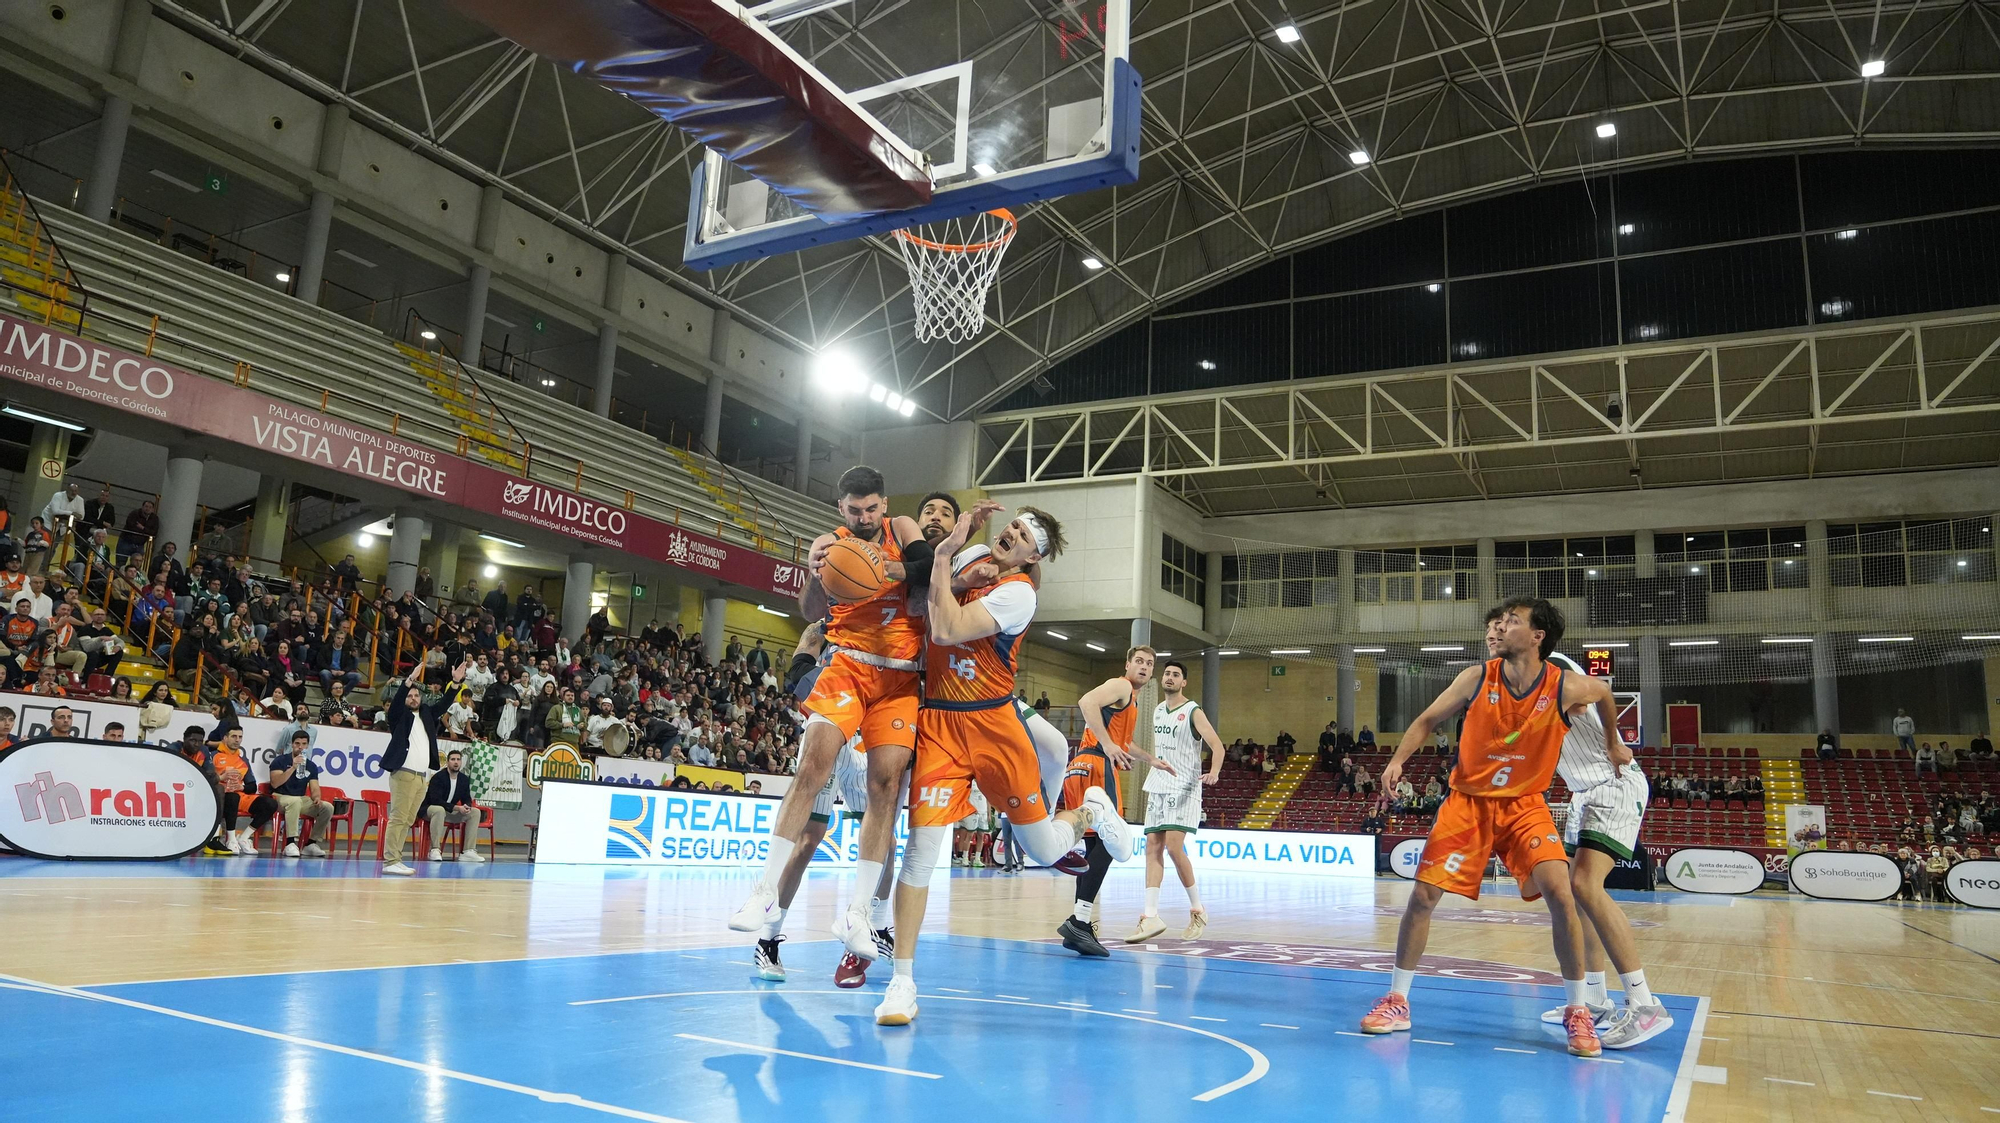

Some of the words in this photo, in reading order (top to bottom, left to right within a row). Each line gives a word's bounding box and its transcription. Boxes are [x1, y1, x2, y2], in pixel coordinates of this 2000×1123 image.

[211, 179, 220, 190] 3
[535, 321, 542, 331] 4
[47, 376, 63, 388] de
[66, 380, 119, 404] Deportes
[121, 396, 167, 418] Córdoba
[268, 403, 321, 429] PALACIO
[322, 421, 383, 448] MUNICIPAL
[385, 440, 436, 465] DEPORTES
[252, 415, 334, 465] VISTA
[342, 446, 447, 496] ALEGRE
[533, 486, 626, 535] IMDECO
[502, 506, 529, 521] Instituto
[530, 515, 561, 531] Municipal
[561, 524, 570, 533] de
[570, 527, 598, 542] Deportes
[598, 534, 623, 548] Córdoba
[688, 540, 727, 561] AYUNTAMIENTO
[688, 552, 695, 563] DE
[695, 555, 720, 571] CÓRDOBA
[635, 586, 642, 596] D
[881, 607, 898, 626] 7
[949, 654, 976, 680] 45
[1275, 667, 1281, 675] K
[1589, 661, 1610, 675] 24
[1491, 767, 1512, 787] 6
[90, 781, 186, 819] rahi
[920, 786, 953, 808] 45
[90, 817, 146, 828] INSTALACIONES
[148, 819, 187, 829] ELÉCTRICAS
[665, 797, 772, 834] REALE
[661, 836, 770, 861] SEGUROS
[1195, 840, 1257, 860] TODA
[1264, 843, 1293, 862] LA
[1299, 844, 1355, 865] VIDA
[1444, 851, 1466, 873] 6
